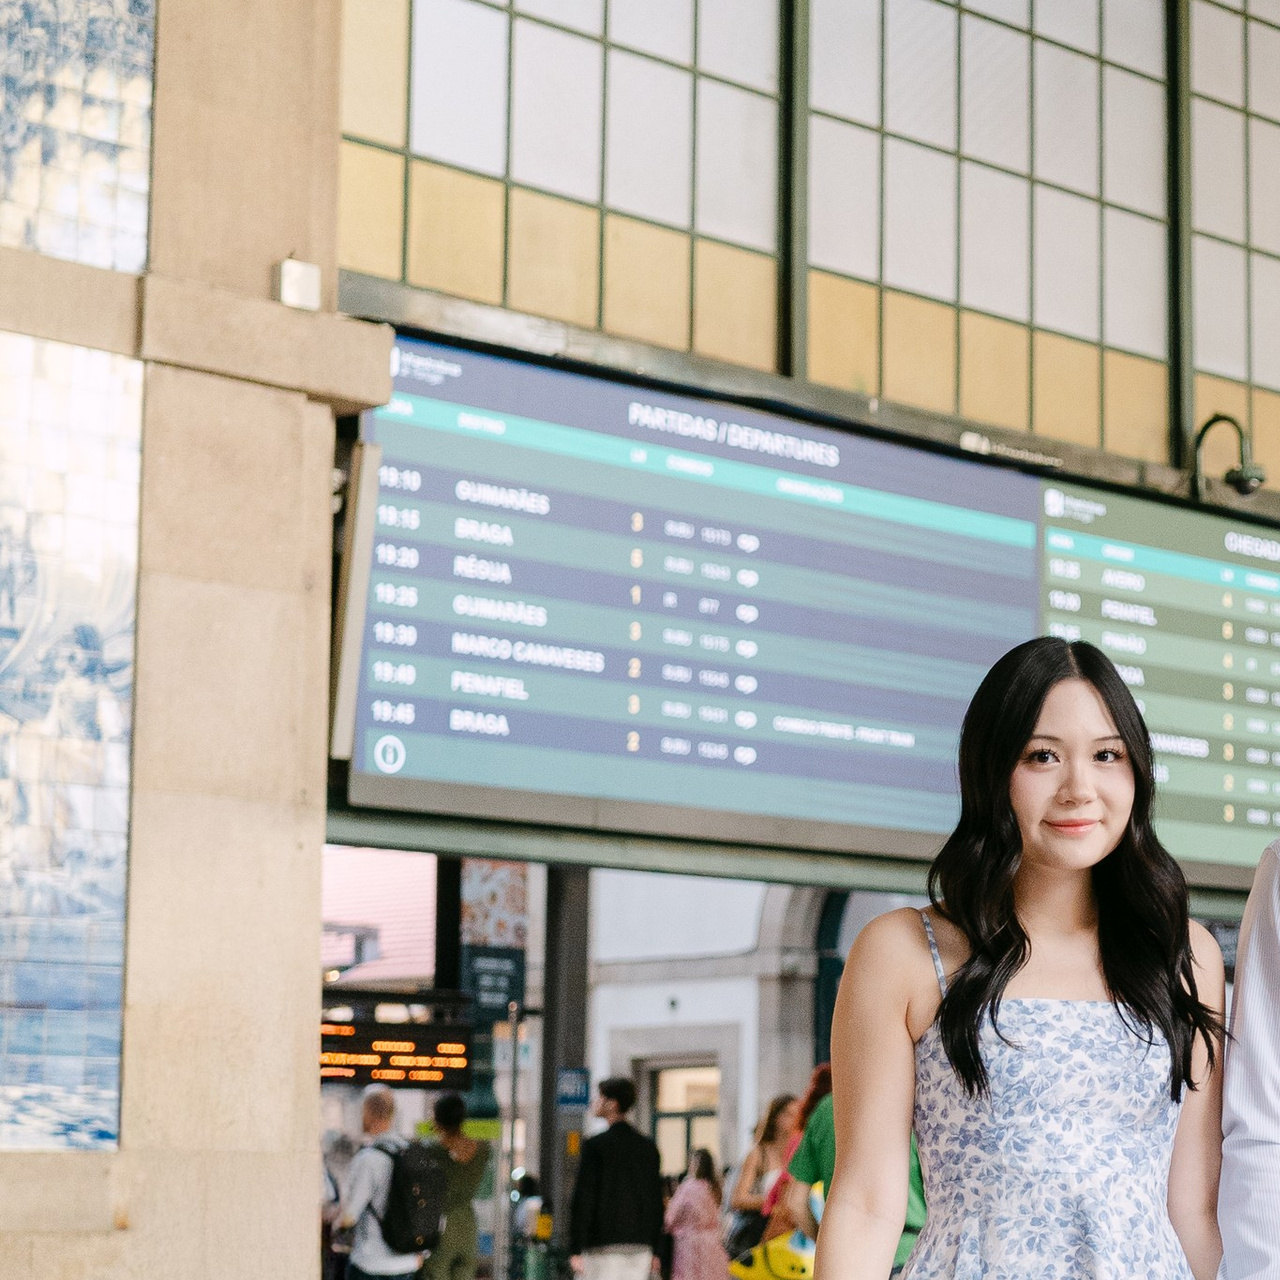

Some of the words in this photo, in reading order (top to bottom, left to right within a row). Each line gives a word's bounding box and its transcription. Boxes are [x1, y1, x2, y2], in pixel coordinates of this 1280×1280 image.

[629, 402, 718, 441] PARTIDAS
[727, 423, 840, 467] DEPARTURES
[455, 480, 550, 515] GUIMARÃES
[455, 518, 514, 546] BRAGA
[453, 554, 512, 584] RÉGUA
[453, 594, 547, 627] GUIMARÃES
[451, 632, 512, 660] MARCO
[511, 640, 605, 673] CANAVESES
[451, 670, 530, 701] PENAFIEL
[449, 709, 510, 736] BRAGA
